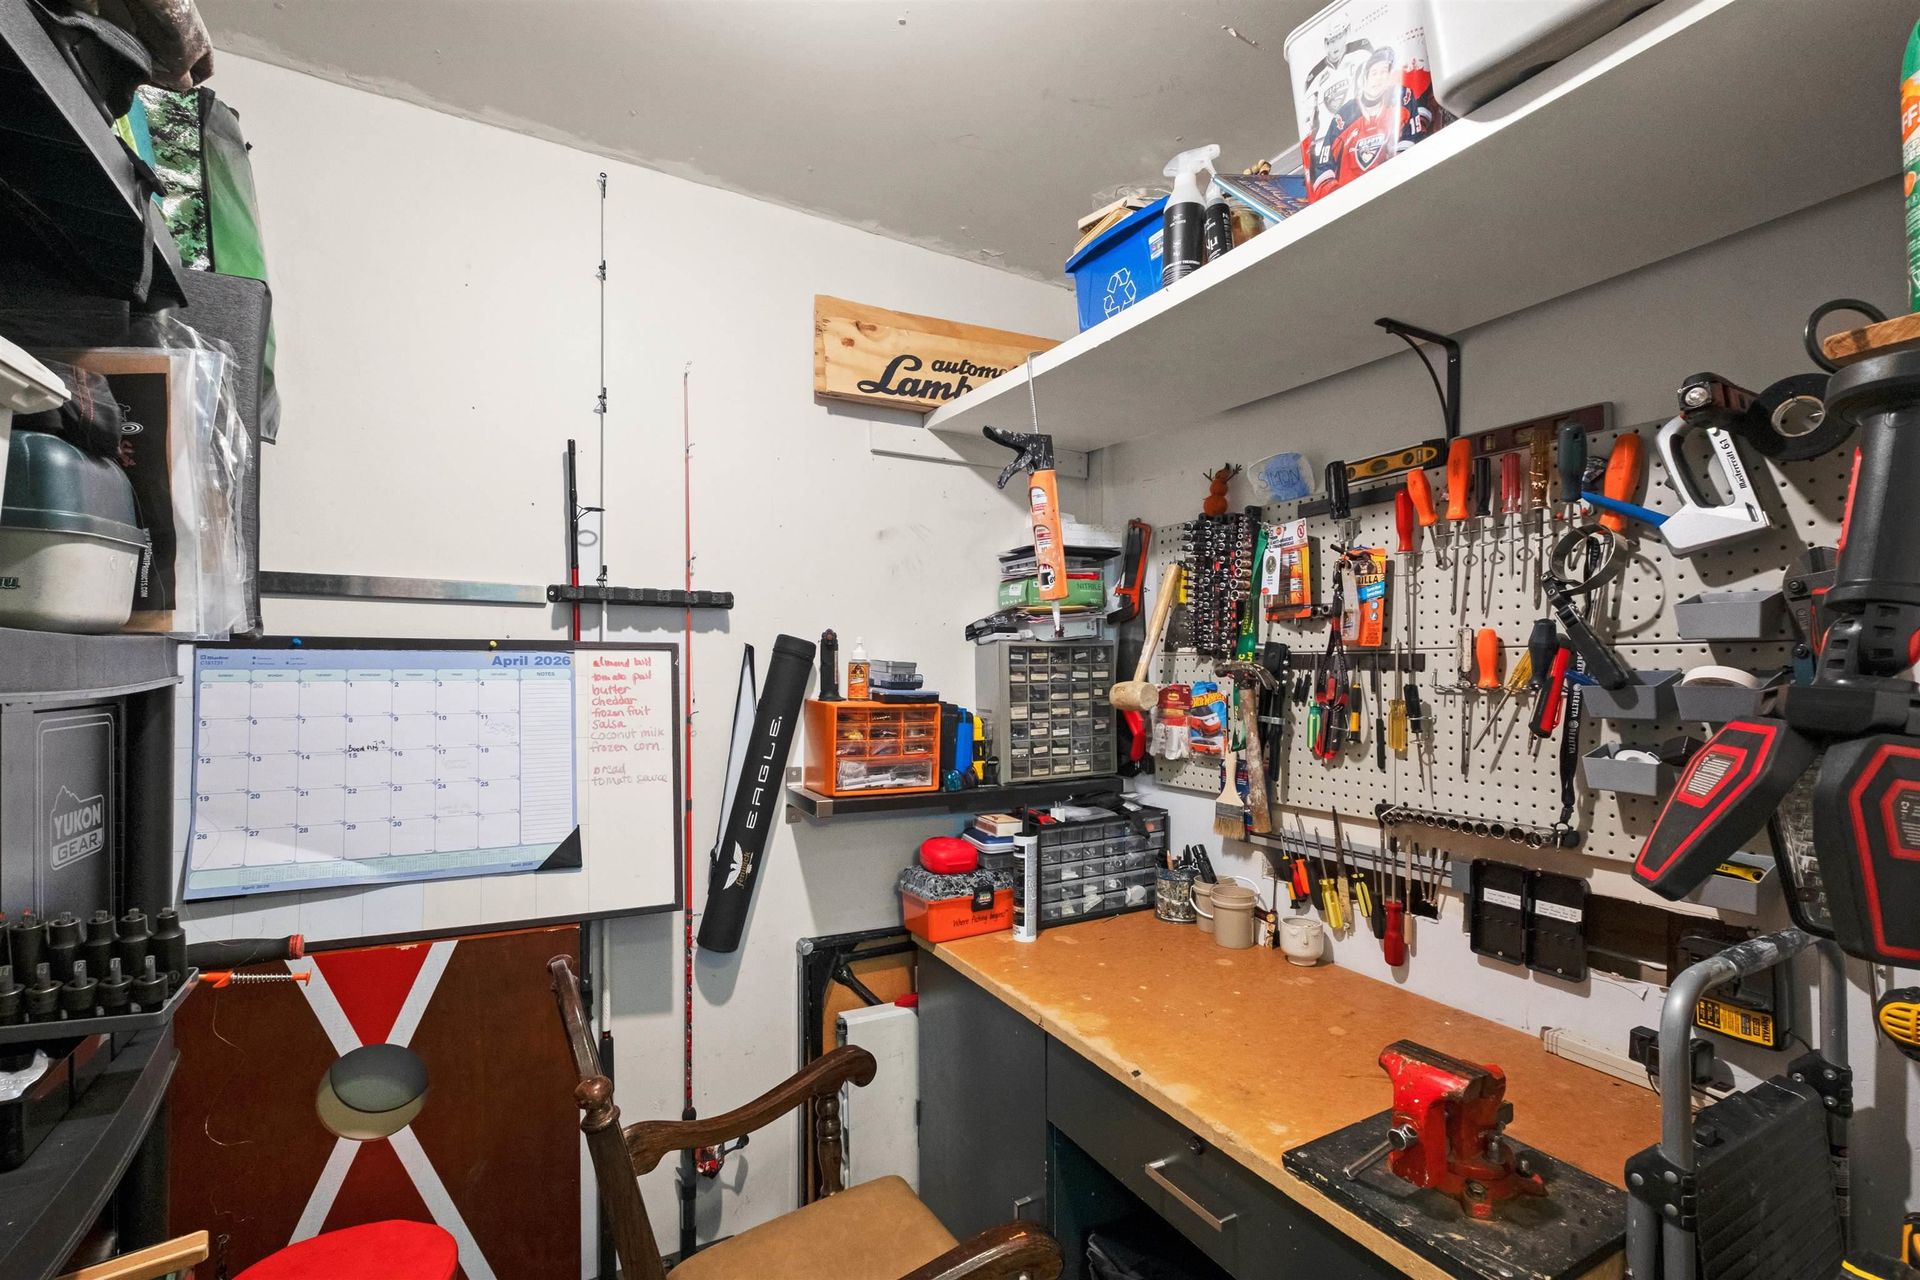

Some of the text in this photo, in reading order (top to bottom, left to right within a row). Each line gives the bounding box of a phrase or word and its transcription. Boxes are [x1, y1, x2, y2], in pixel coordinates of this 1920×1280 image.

[931, 359, 1018, 379] automo
[492, 655, 571, 667] April 2026
[592, 685, 631, 695] butter
[1571, 691, 1581, 718] BERETTA
[592, 706, 651, 717] frozen fruit
[590, 727, 664, 740] coconut milk
[590, 741, 659, 752] frozen corn
[54, 803, 101, 839] YUKON
[58, 833, 97, 861] GEAR
[74, 962, 84, 972] 12
[110, 959, 120, 969] 11
